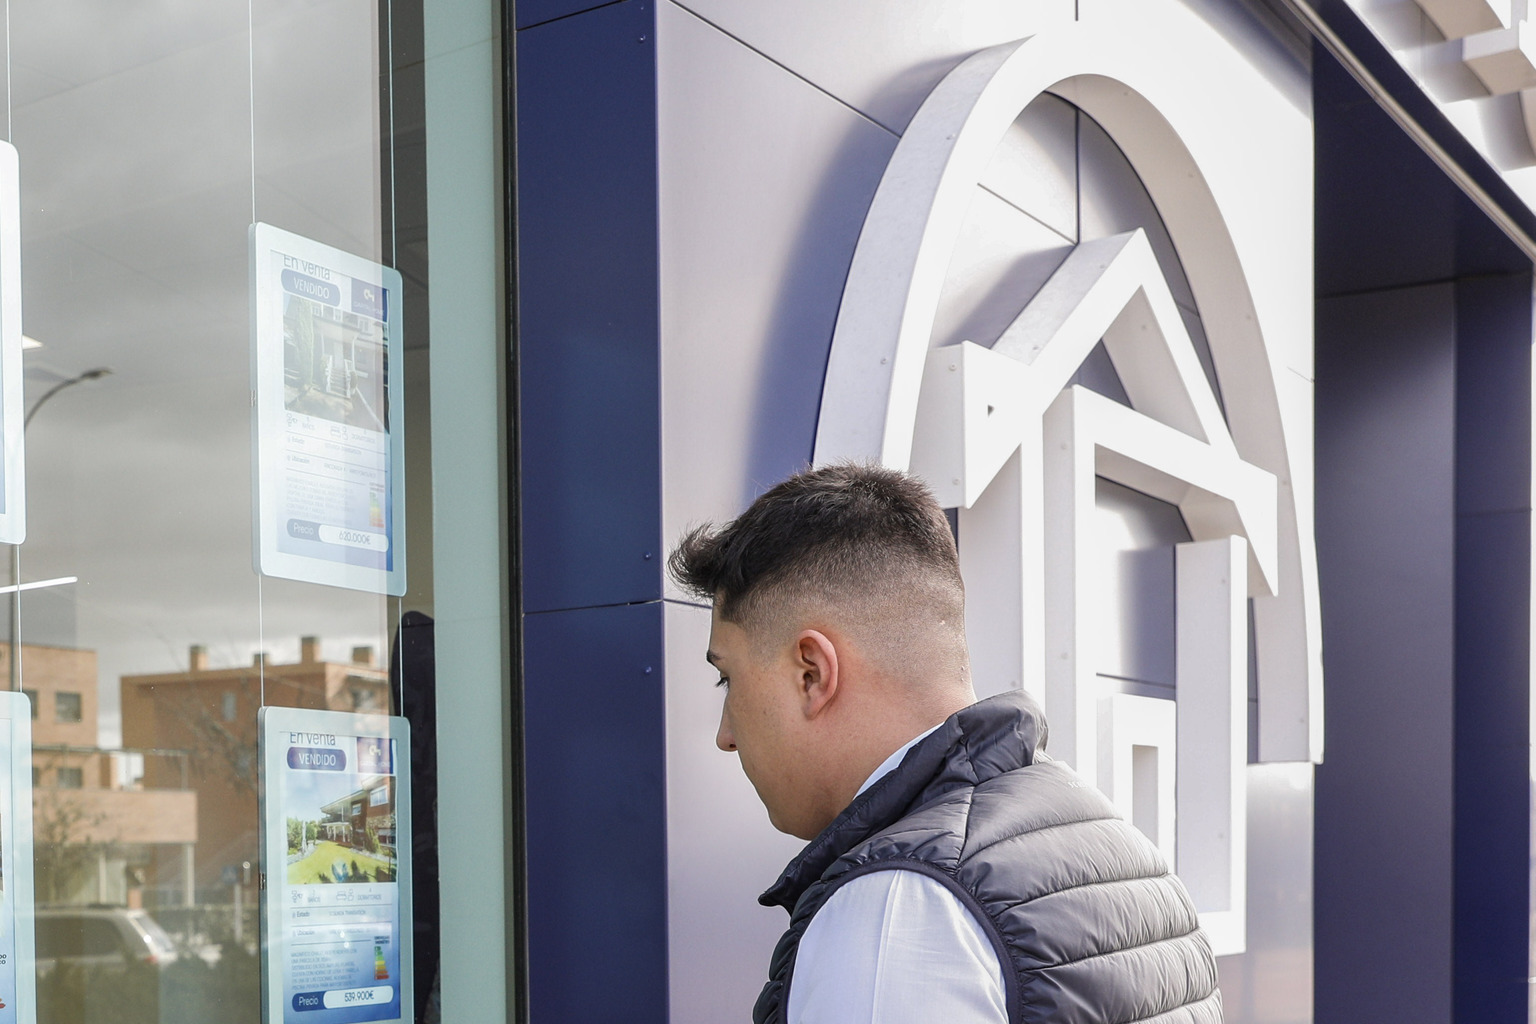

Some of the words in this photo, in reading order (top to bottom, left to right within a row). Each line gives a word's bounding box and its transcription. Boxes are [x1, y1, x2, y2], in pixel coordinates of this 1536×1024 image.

[283, 254, 298, 269] En
[302, 260, 331, 281] venta
[293, 277, 330, 299] VENDIDO
[293, 522, 314, 536] Precio
[289, 732, 303, 744] En
[307, 733, 336, 746] venta
[298, 753, 336, 766] VENDIDO
[298, 996, 319, 1006] Precio
